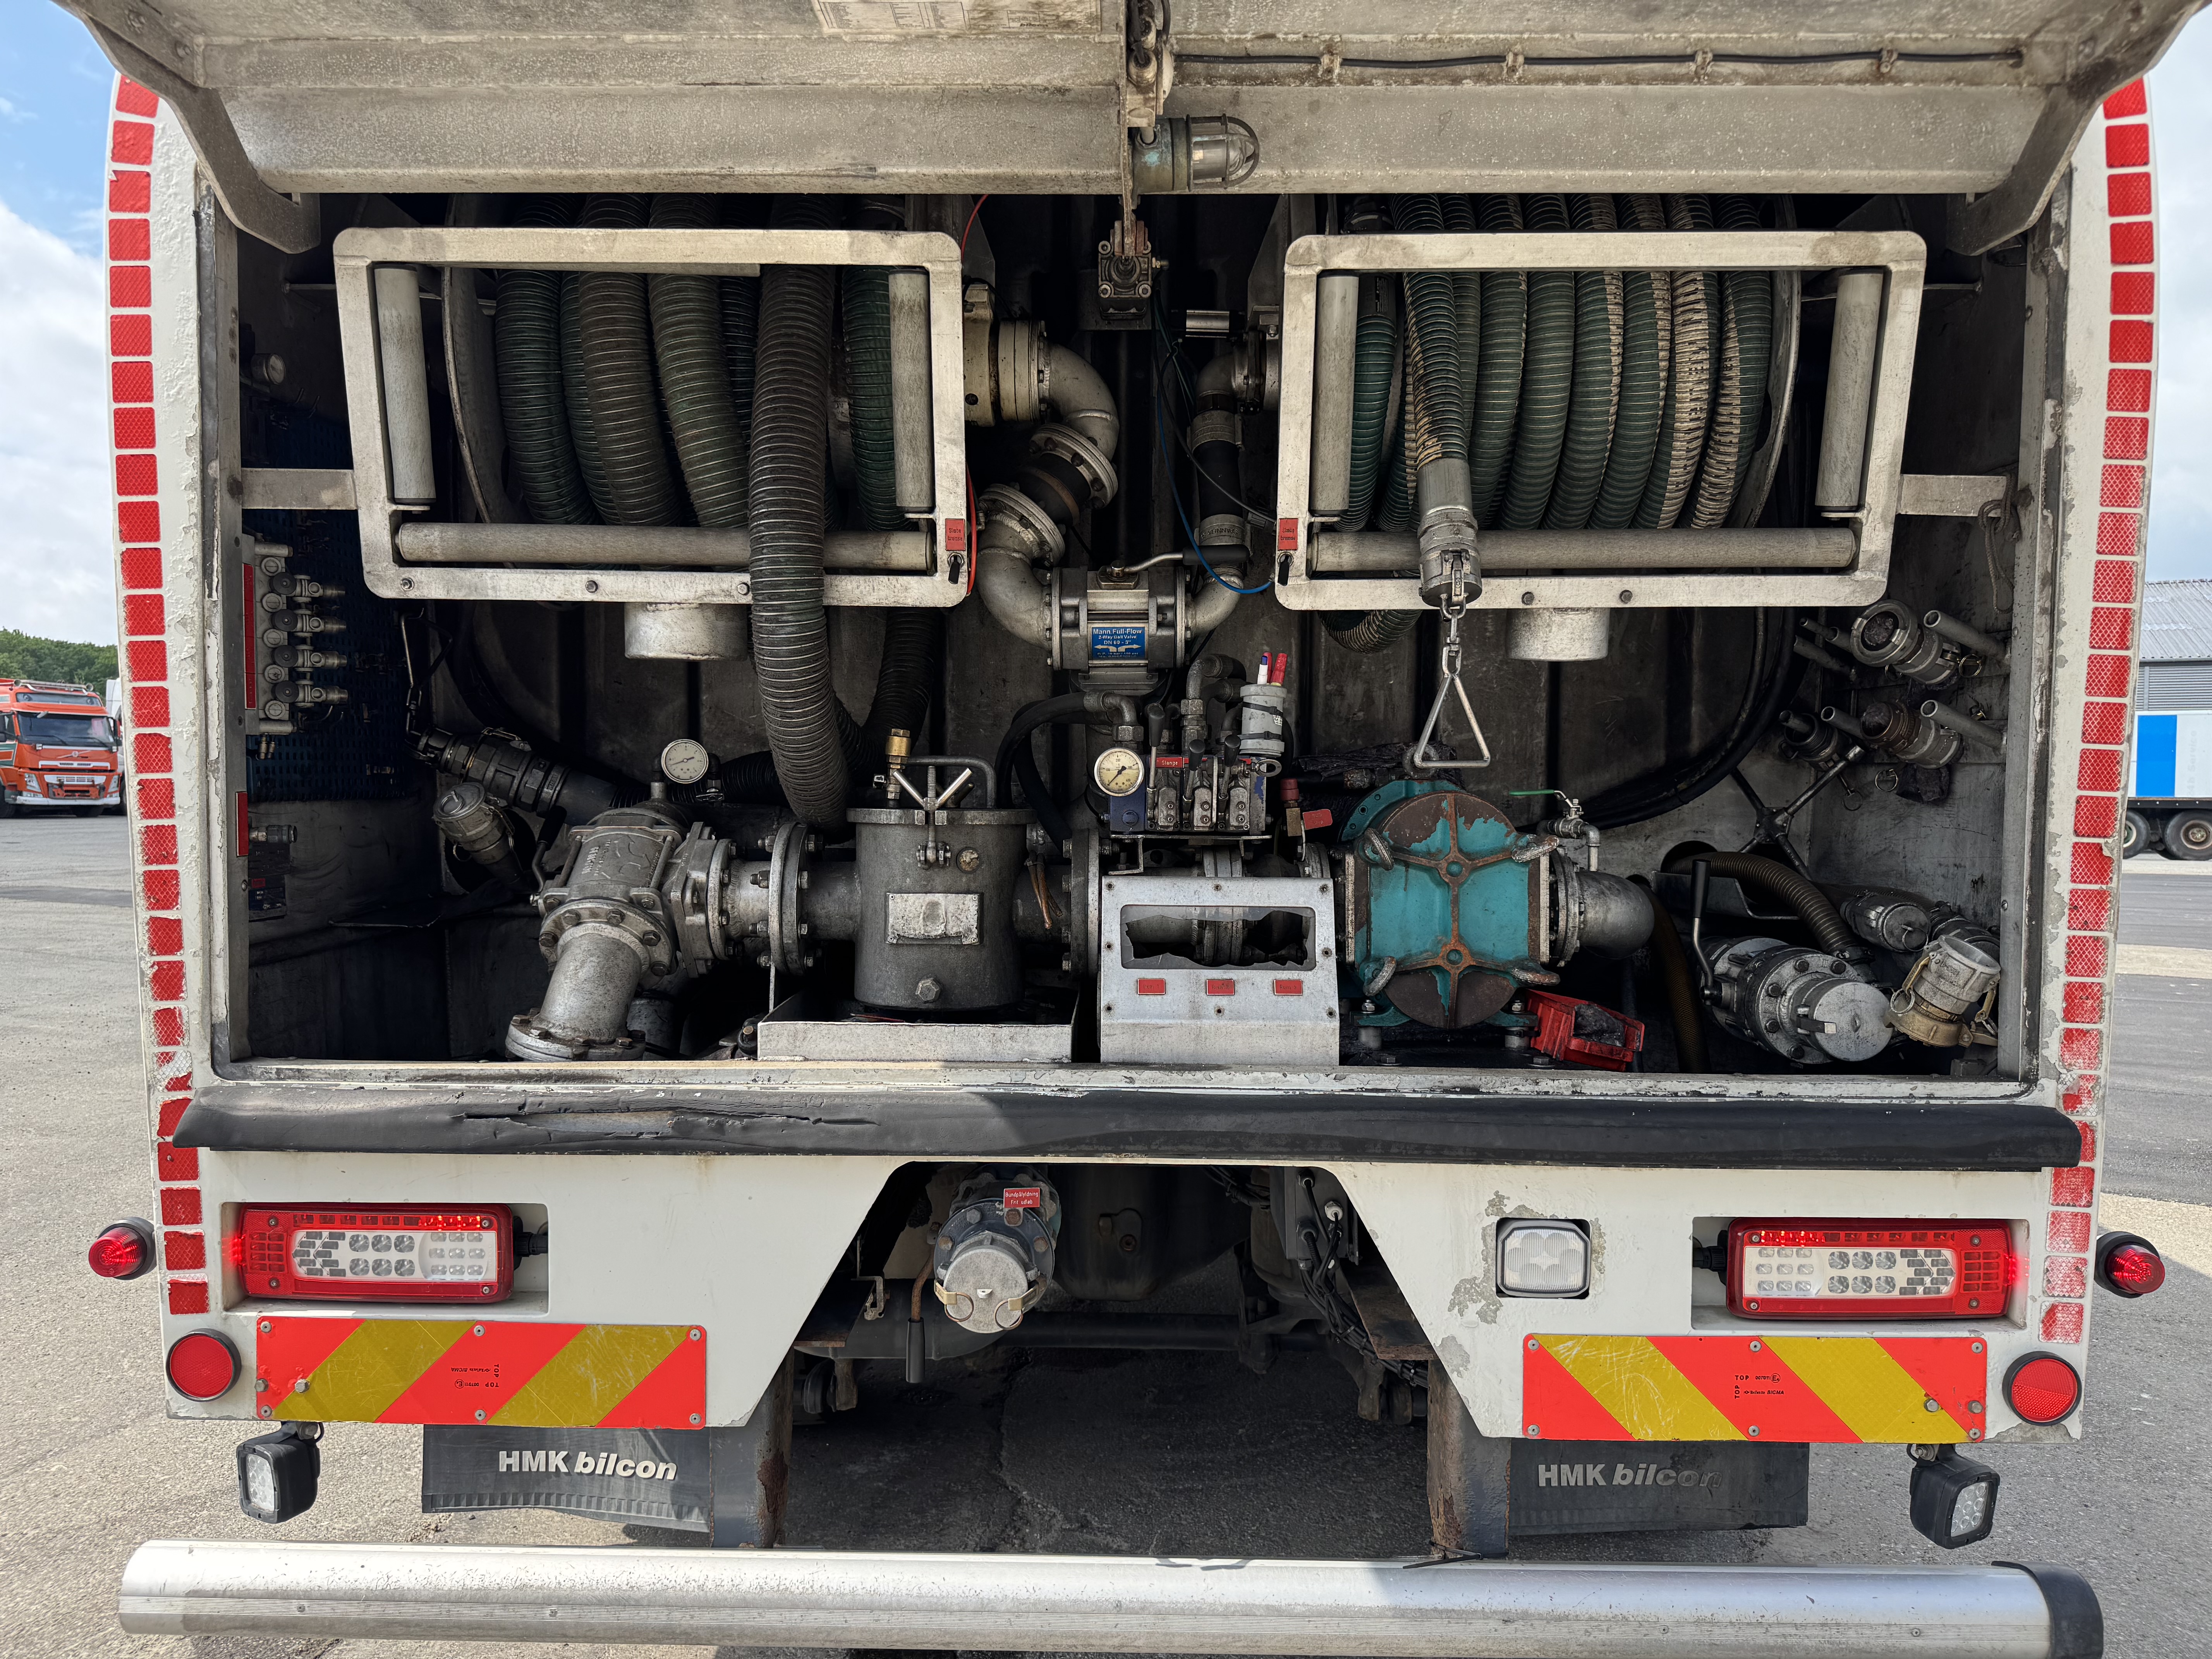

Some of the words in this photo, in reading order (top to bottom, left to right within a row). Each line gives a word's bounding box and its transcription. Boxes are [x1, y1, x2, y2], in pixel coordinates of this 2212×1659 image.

[2187, 730, 2197, 772] Service
[499, 1450, 569, 1473] HMK
[574, 1451, 677, 1480] bilcon
[1538, 1463, 1606, 1487] HMK
[1612, 1463, 1723, 1488] bilcon
